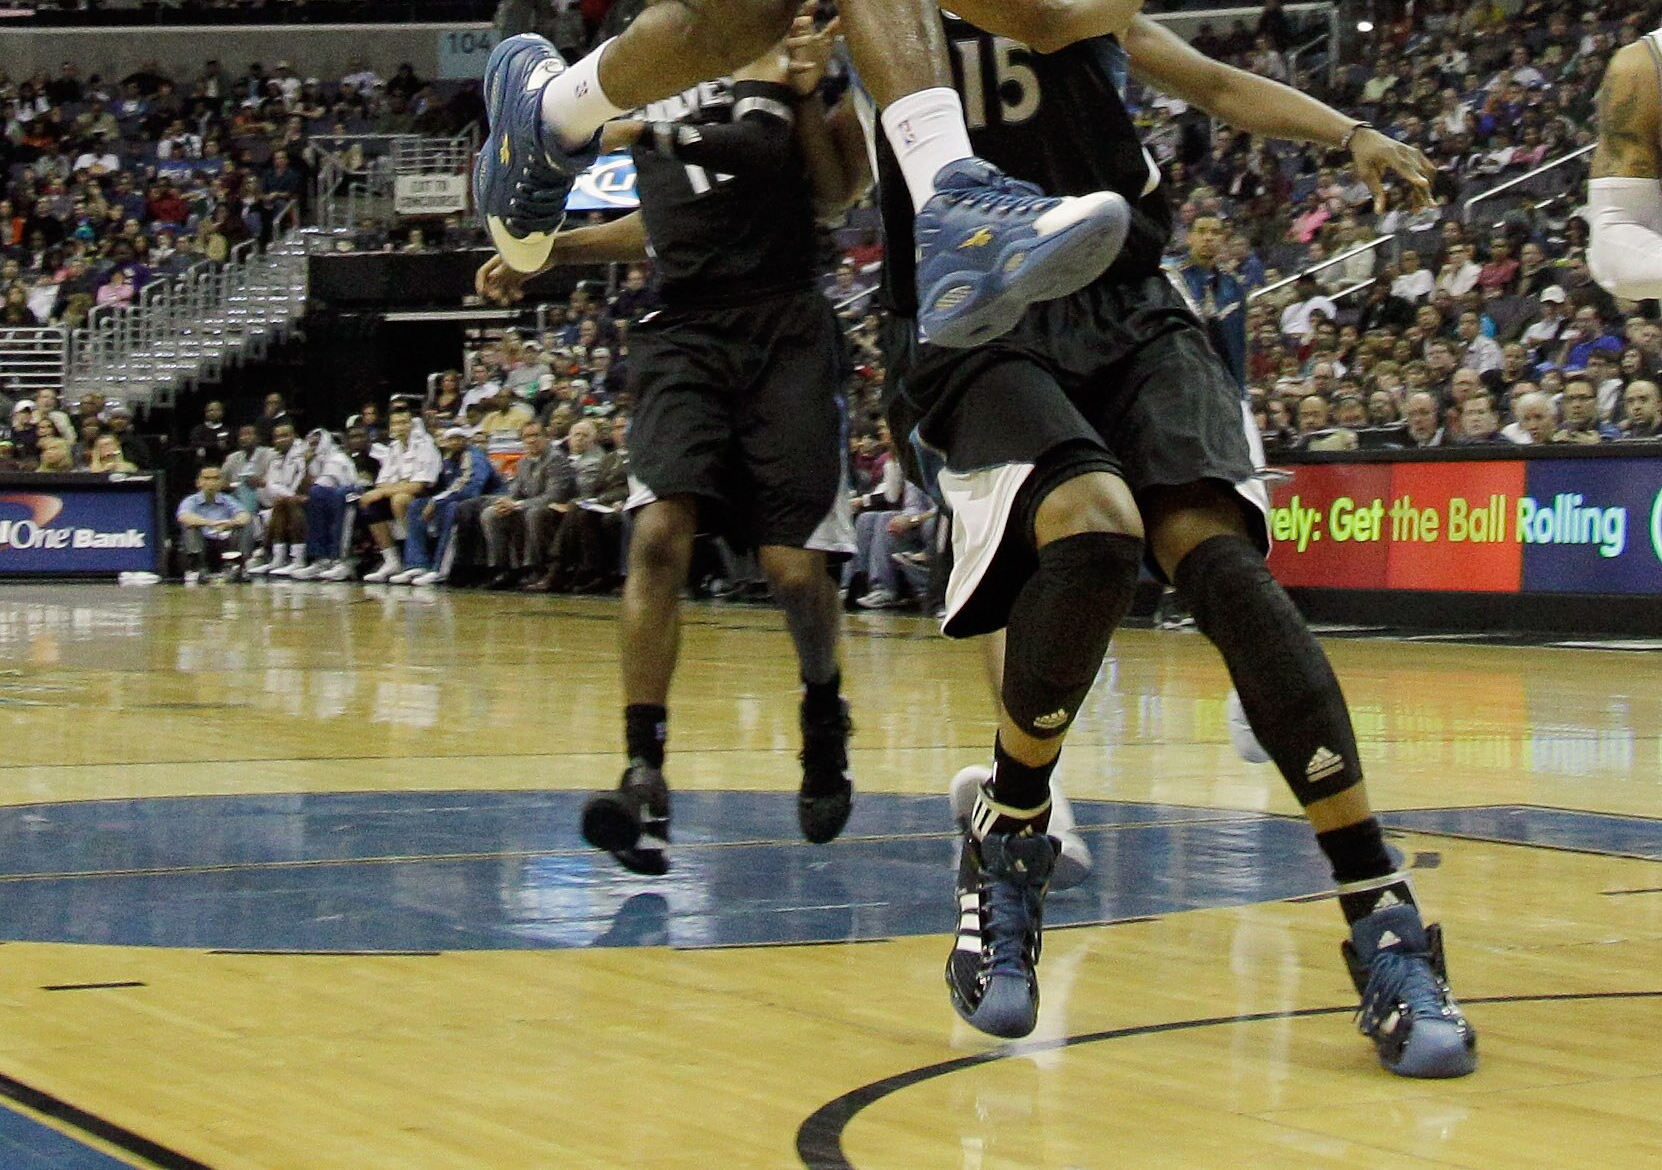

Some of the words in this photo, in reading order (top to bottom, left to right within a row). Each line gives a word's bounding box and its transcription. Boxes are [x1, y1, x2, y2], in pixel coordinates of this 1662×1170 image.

[448, 32, 490, 54] 104
[954, 36, 1041, 128] 15
[73, 528, 145, 549] Bank
[1329, 496, 1385, 543] Get
[1390, 494, 1440, 543] the
[1448, 494, 1507, 543] Ball
[1515, 492, 1627, 558] Rolling
